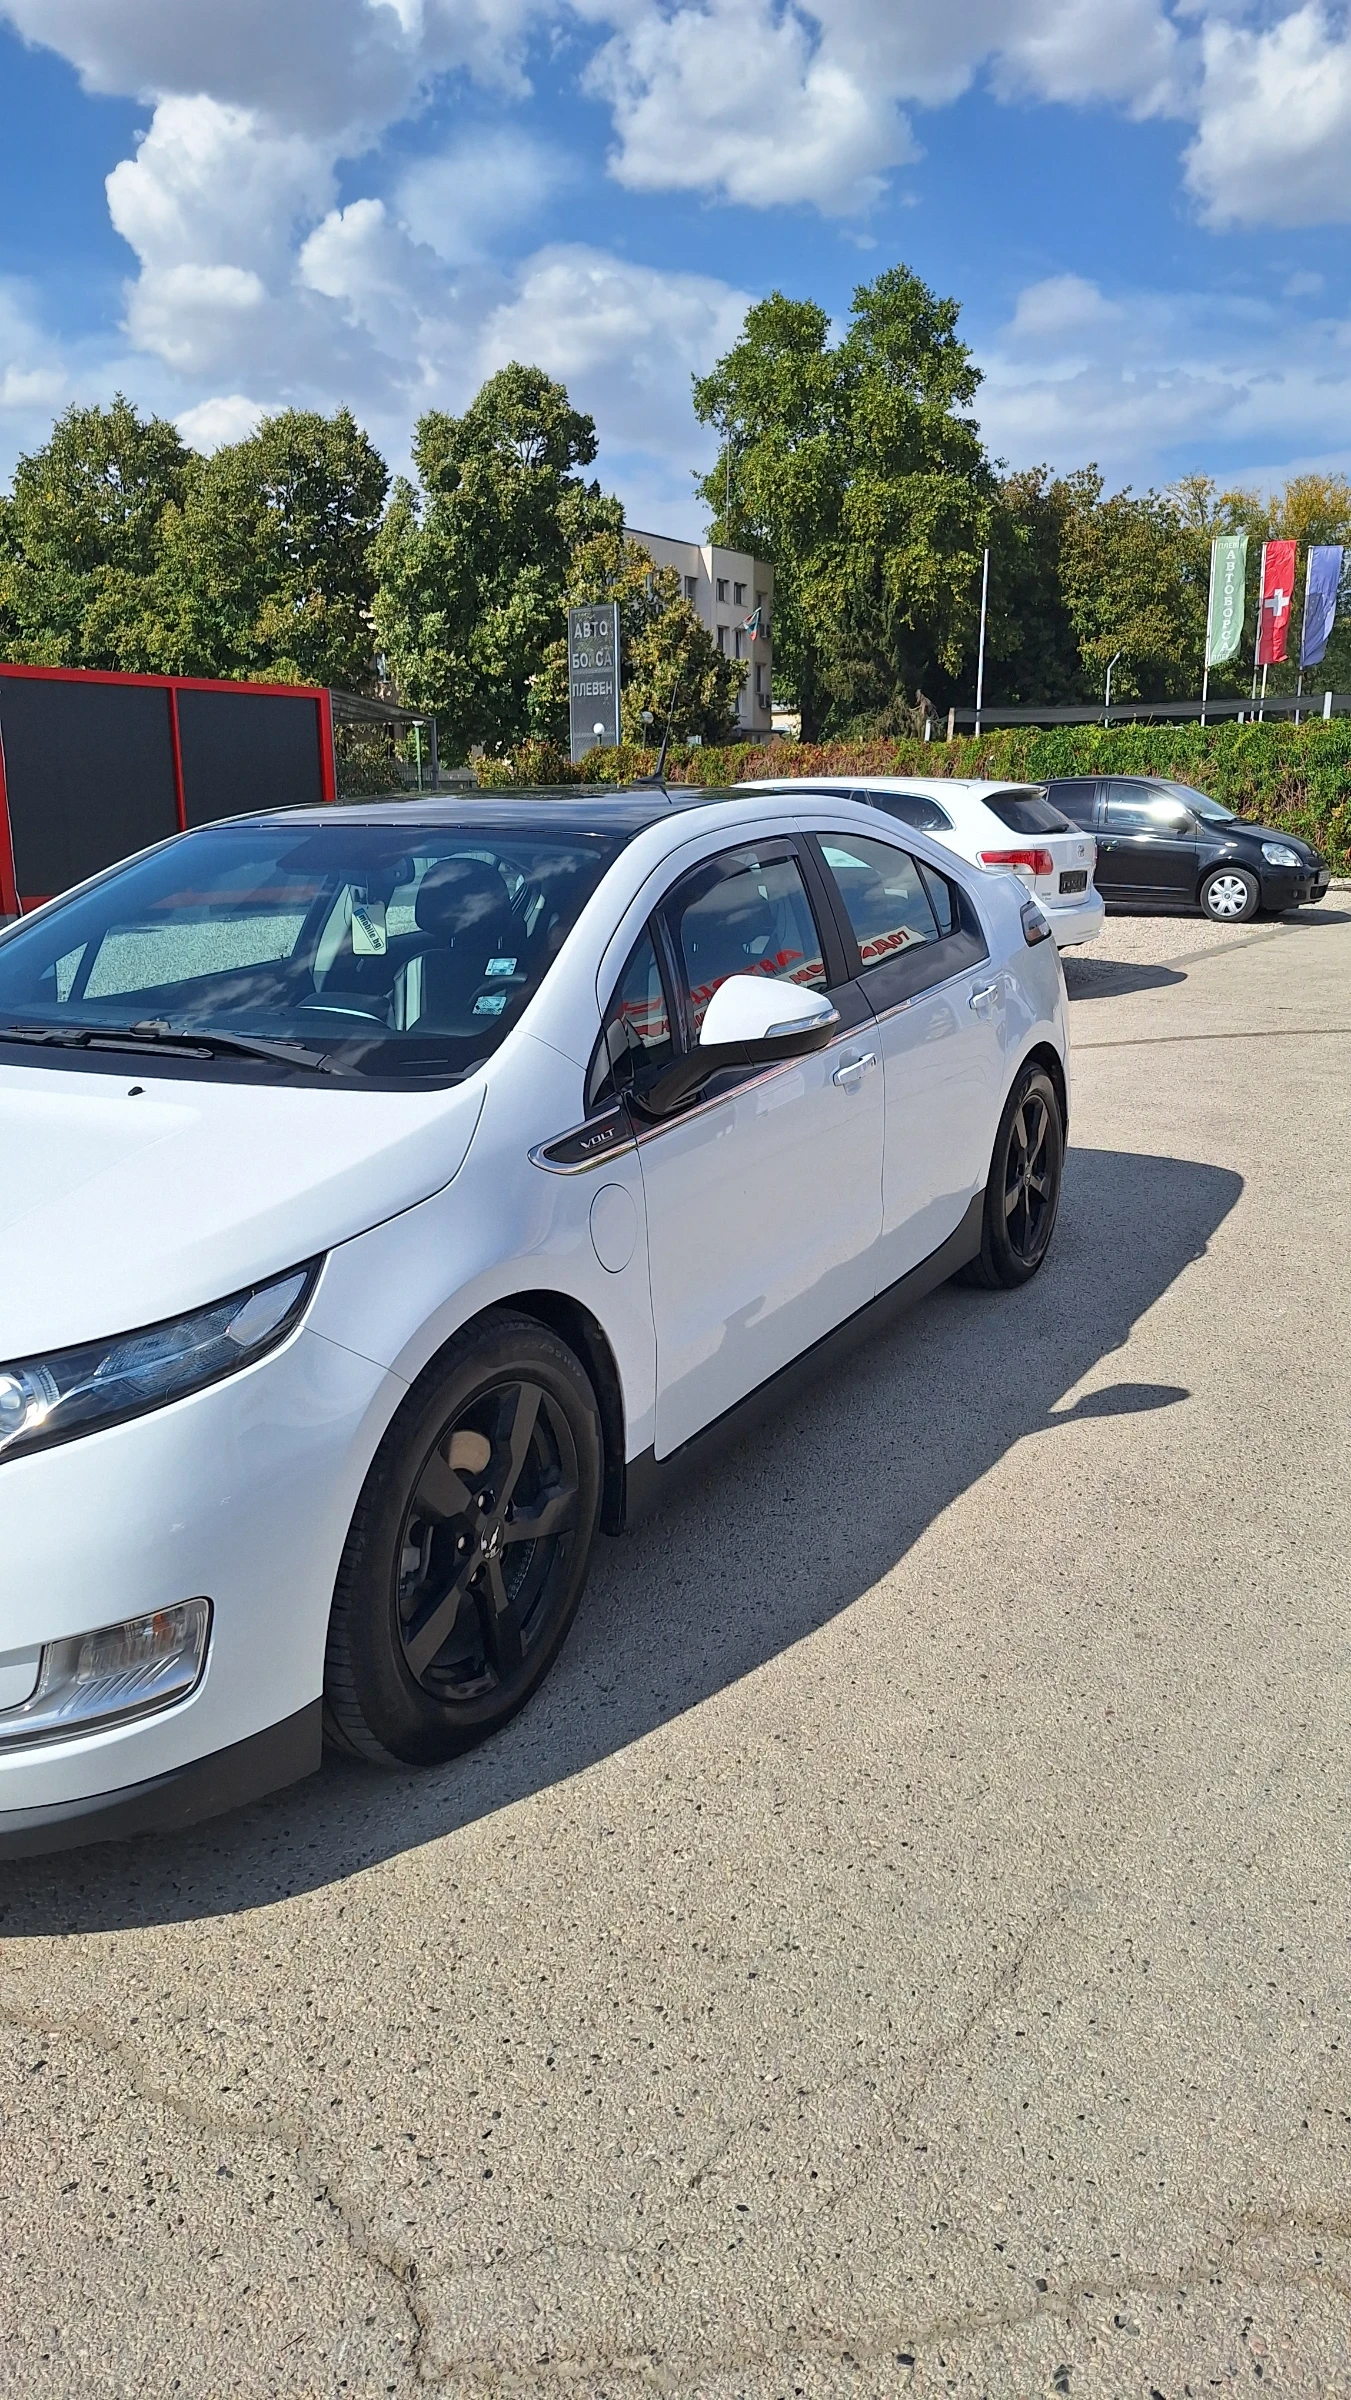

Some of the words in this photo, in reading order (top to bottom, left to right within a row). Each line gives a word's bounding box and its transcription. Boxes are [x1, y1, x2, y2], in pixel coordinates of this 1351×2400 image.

[1219, 550, 1236, 652] АВТОБОРСА
[574, 621, 608, 639] АВТО
[572, 681, 613, 697] ПЛЕВЕН
[358, 914, 382, 949] mobile.bg
[580, 1127, 615, 1150] VOLT
